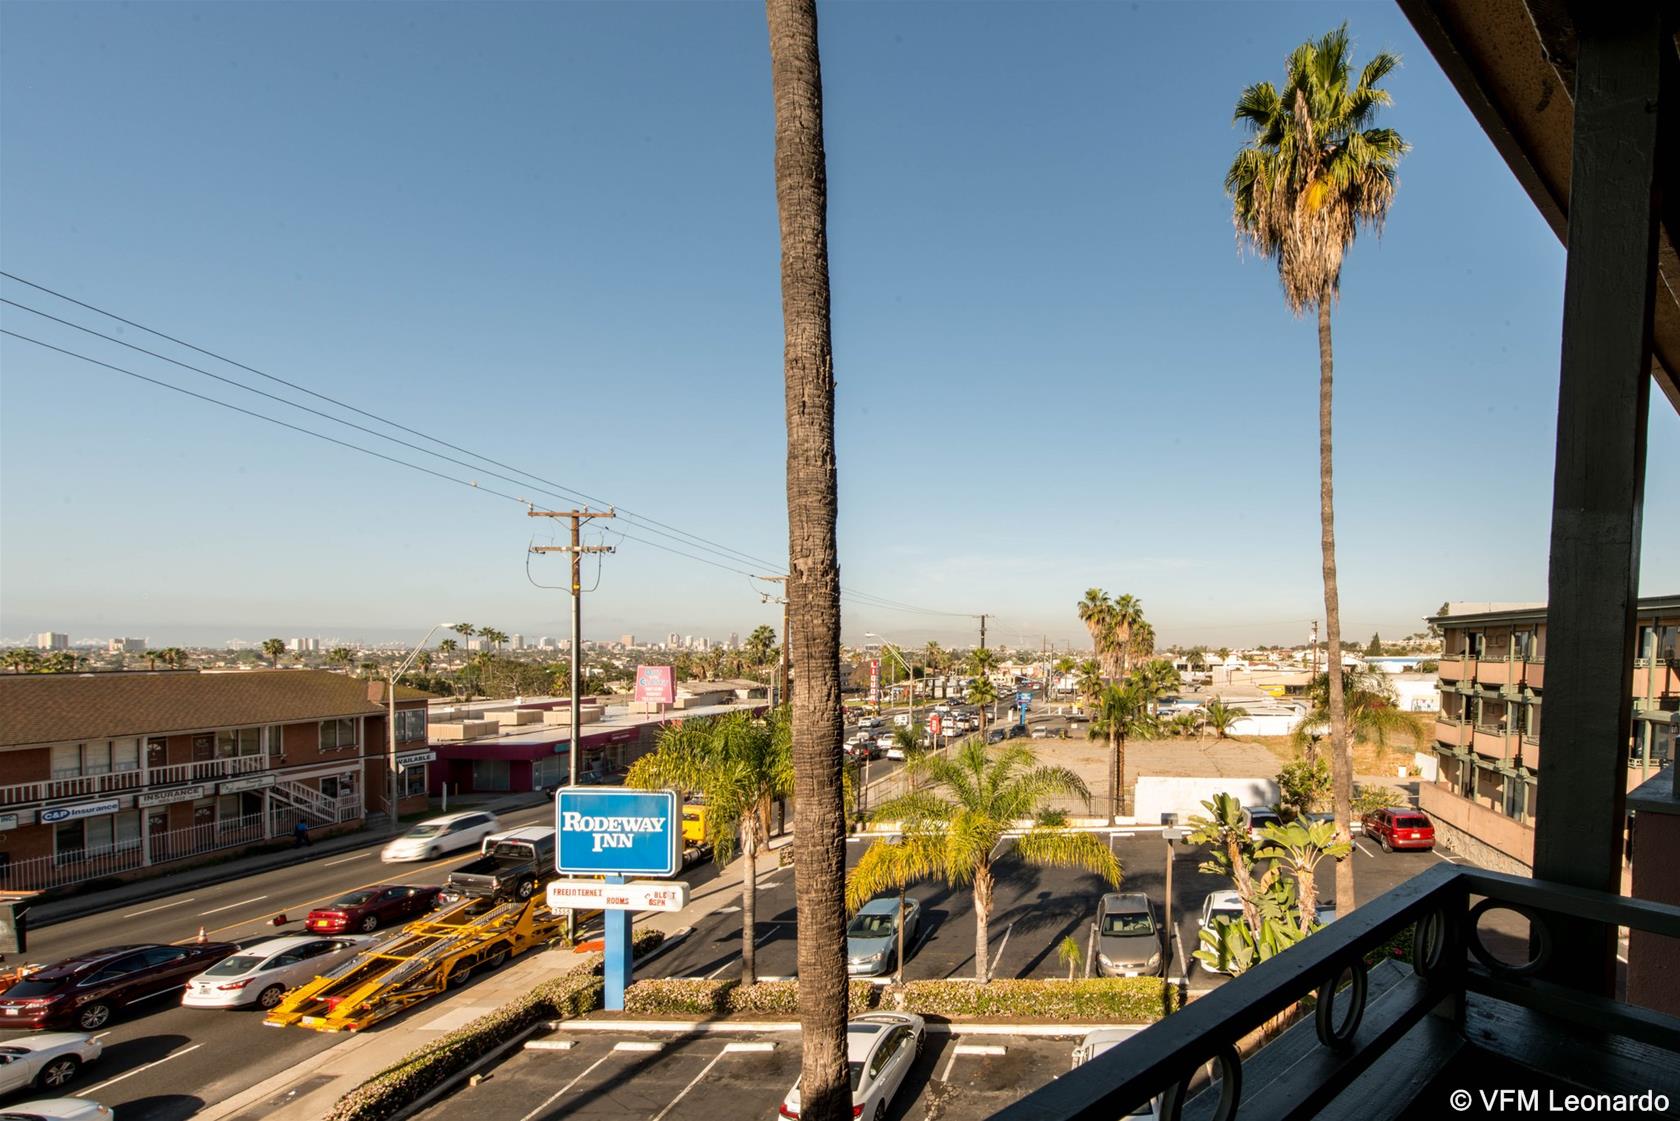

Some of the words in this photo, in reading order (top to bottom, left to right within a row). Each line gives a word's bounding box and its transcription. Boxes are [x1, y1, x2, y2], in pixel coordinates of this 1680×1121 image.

[398, 754, 432, 764] VAILABLE
[143, 788, 200, 801] INSURANCE
[44, 811, 68, 821] C&P
[71, 803, 118, 816] Insurance
[562, 811, 666, 832] RODEWAY
[592, 833, 634, 852] INN
[606, 897, 630, 905] ROOMS
